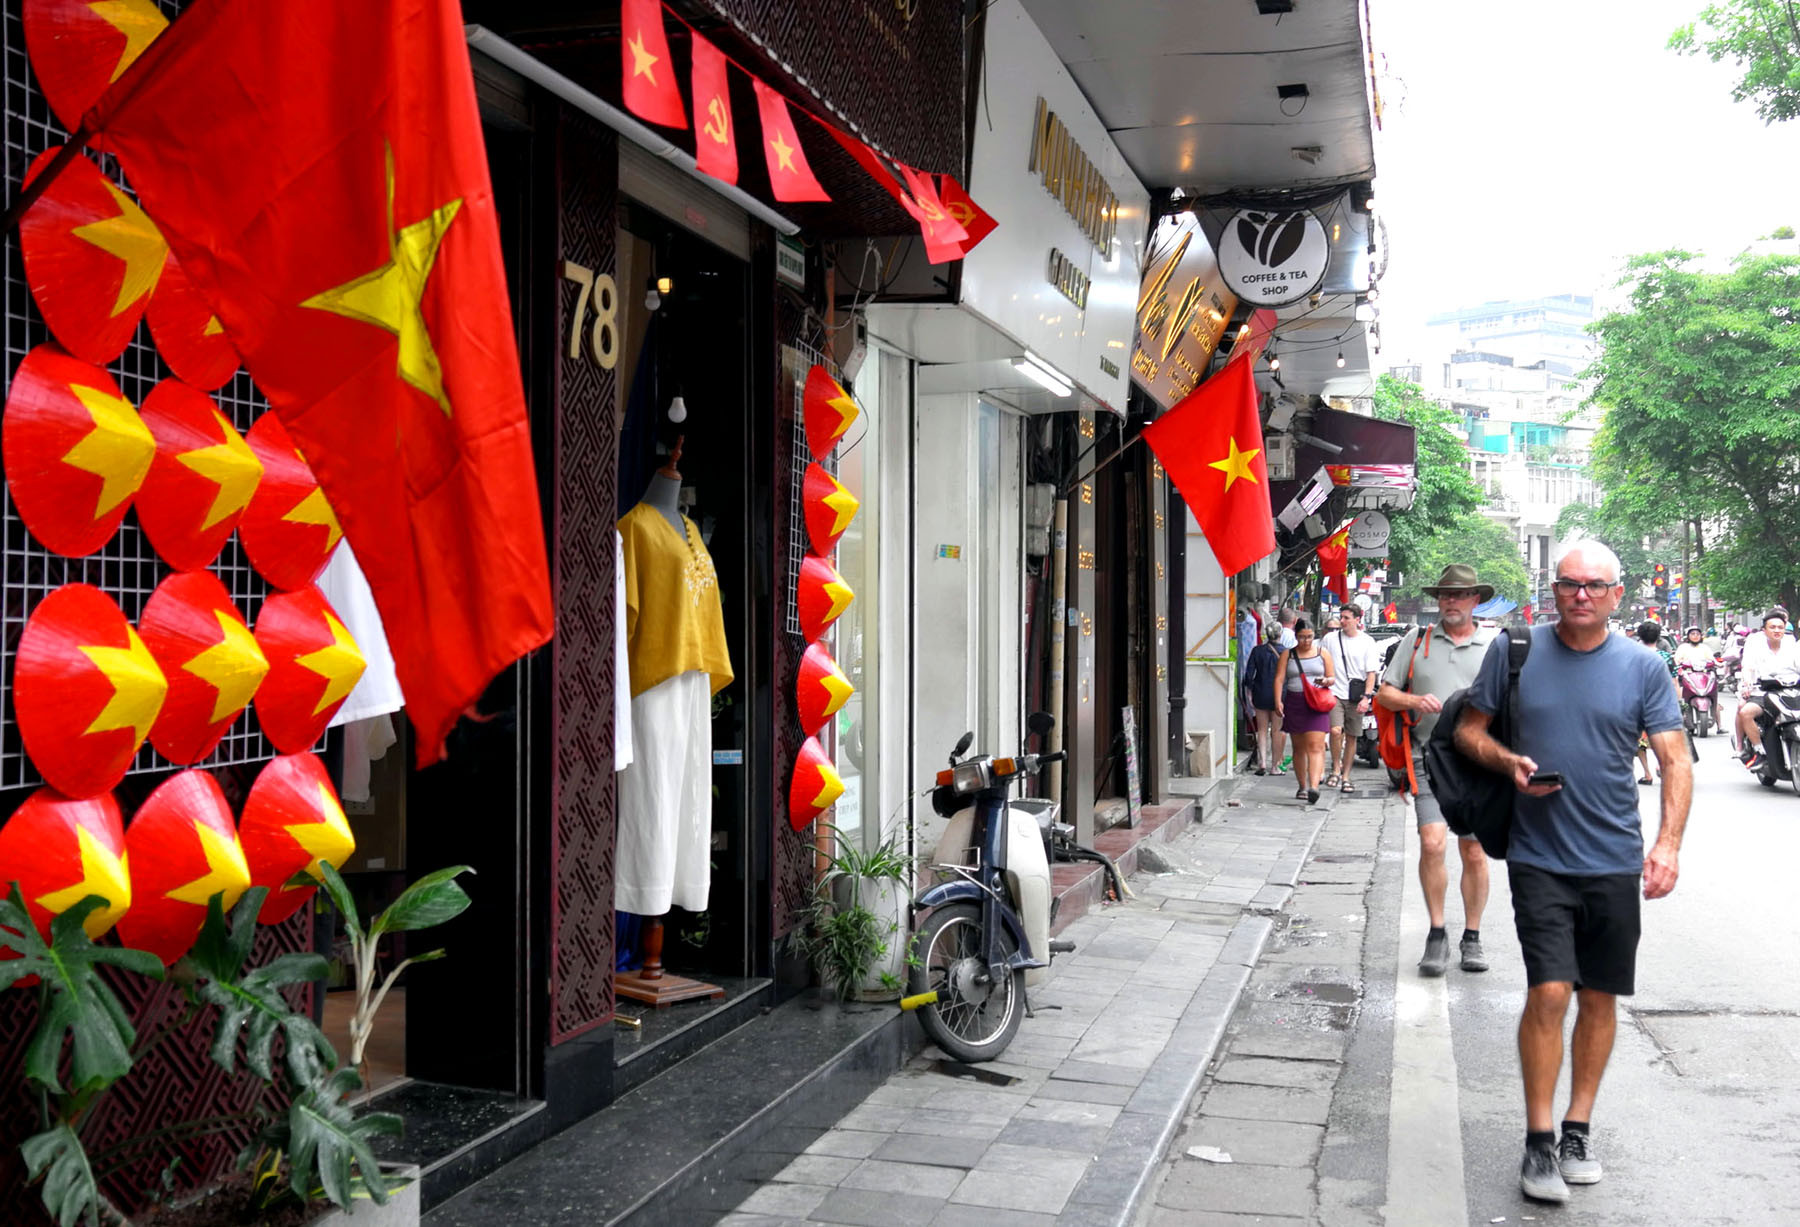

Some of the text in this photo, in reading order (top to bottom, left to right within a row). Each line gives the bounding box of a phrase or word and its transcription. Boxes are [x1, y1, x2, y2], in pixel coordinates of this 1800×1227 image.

[1048, 247, 1091, 310] GALLERY
[1242, 271, 1308, 283] COFFEE & TEA
[1262, 286, 1288, 295] SHOP
[564, 260, 619, 370] 78
